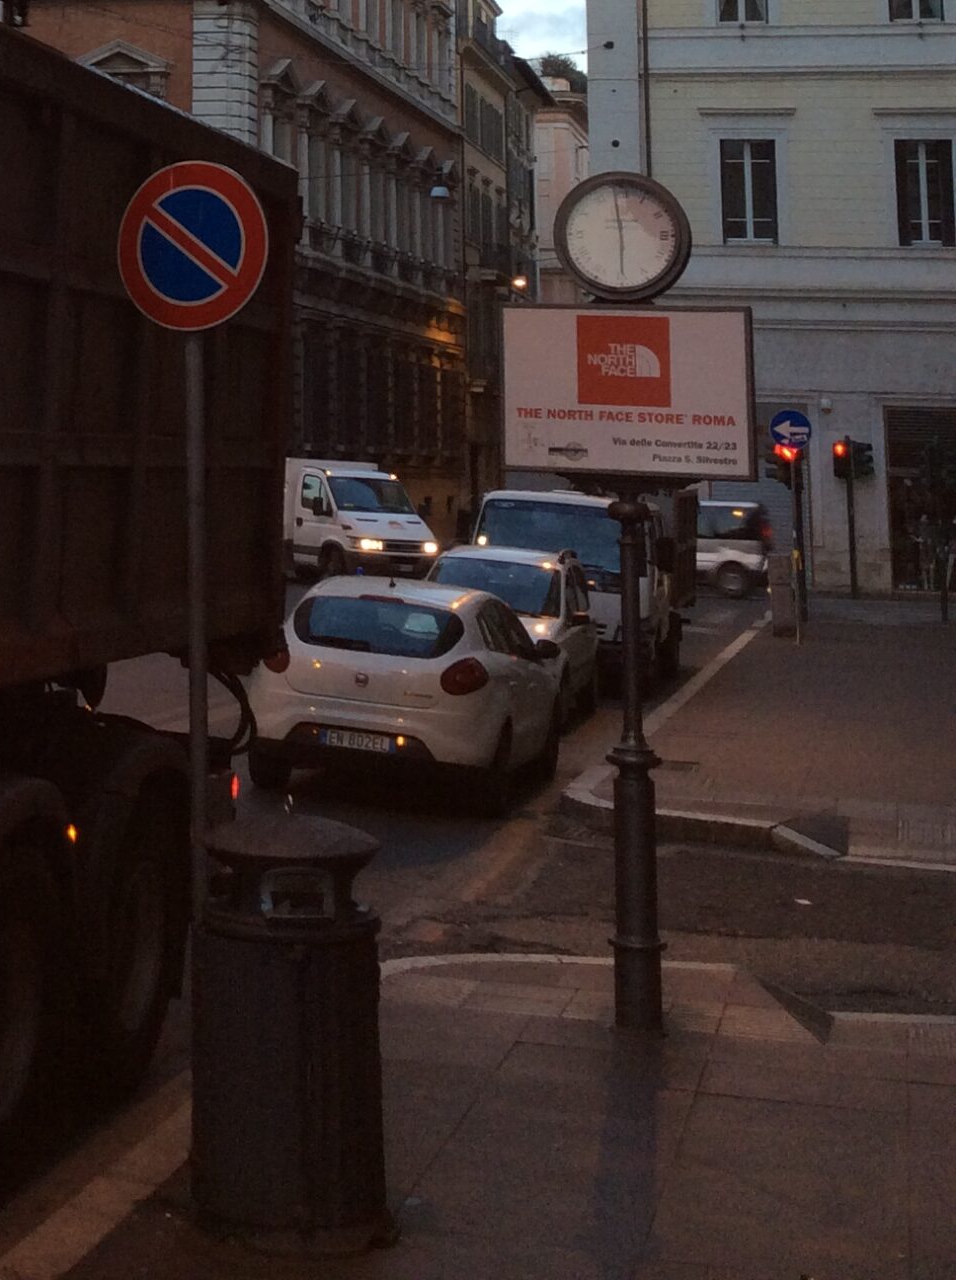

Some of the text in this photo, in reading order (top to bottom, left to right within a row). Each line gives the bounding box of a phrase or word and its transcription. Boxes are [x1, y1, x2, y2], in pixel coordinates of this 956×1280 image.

[608, 343, 635, 355] THE
[587, 354, 635, 366] NORTH
[601, 365, 635, 377] FACE
[516, 407, 736, 427] THE NORTH FACE STORE ROMA
[612, 437, 627, 446] Via
[629, 438, 652, 447] delle
[706, 441, 737, 451] 22/23
[652, 453, 682, 463] Piazza
[696, 455, 738, 465] Silvestro
